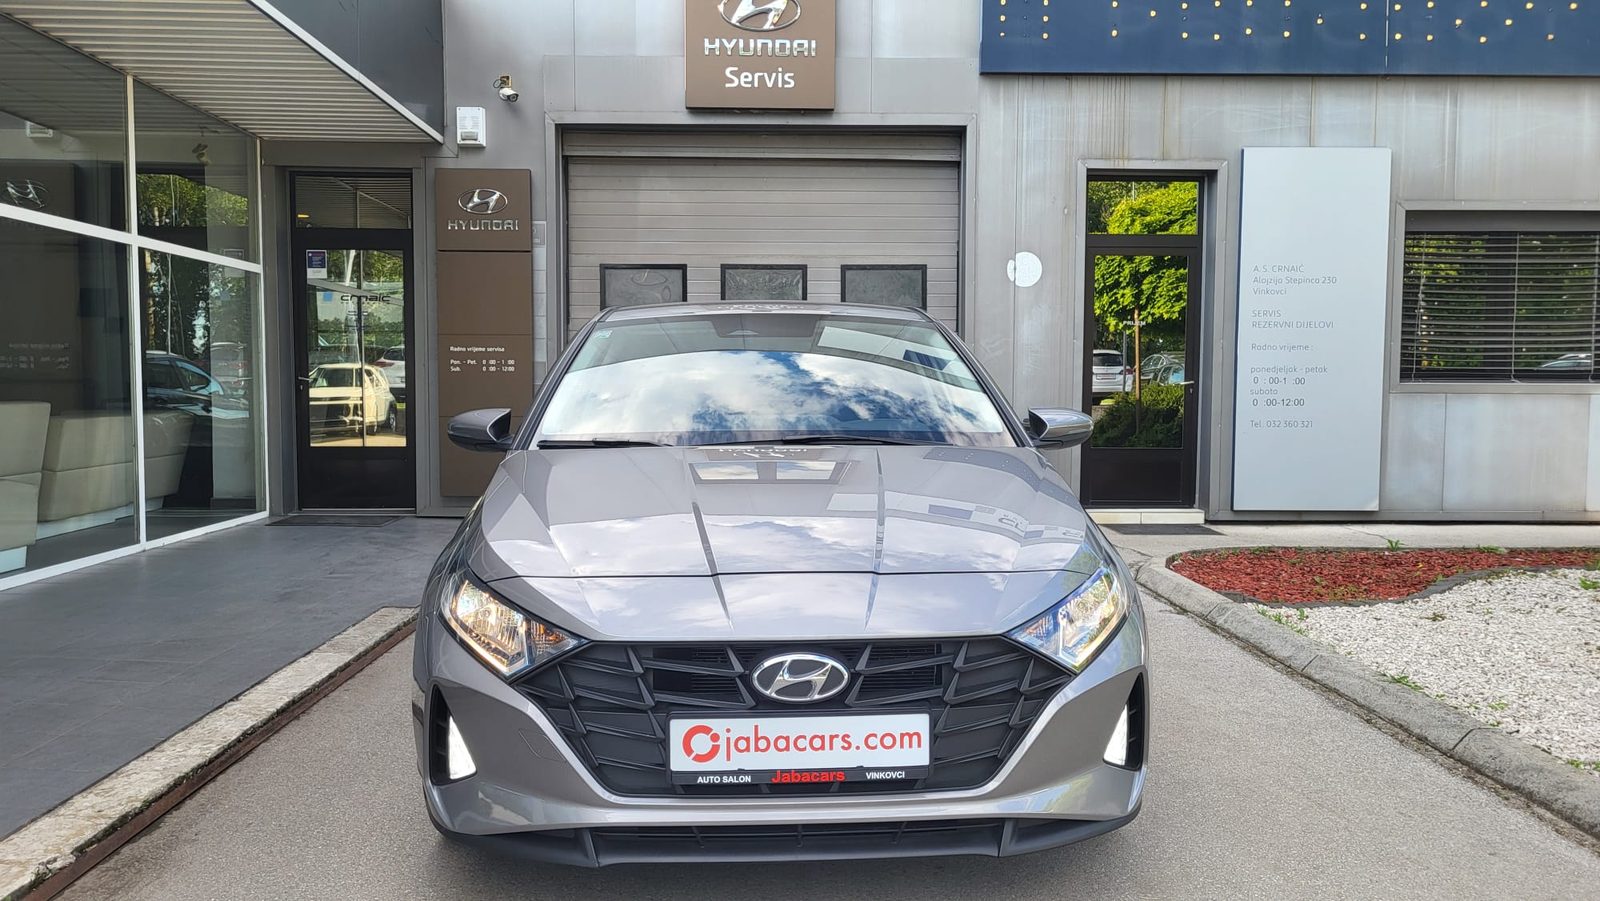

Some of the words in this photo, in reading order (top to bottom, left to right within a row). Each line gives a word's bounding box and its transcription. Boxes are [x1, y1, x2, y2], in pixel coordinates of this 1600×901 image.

[704, 38, 817, 57] HYUNDAI
[724, 66, 795, 88] Servis
[447, 219, 519, 231] HYUNDAI
[1253, 276, 1284, 286] Alojzija
[1285, 276, 1320, 285] Stepinca
[1321, 276, 1337, 285] 230
[1252, 309, 1282, 318] SERVIS
[1252, 320, 1294, 329] REZERVNI
[1295, 320, 1334, 329] DIJELOVI
[1251, 343, 1278, 351] Radno
[1279, 343, 1310, 353] vrijeme
[1250, 365, 1298, 374] ponedjeljak
[1304, 365, 1328, 375] petak
[1249, 387, 1279, 396] subota
[1266, 419, 1282, 428] 032
[1283, 419, 1298, 428] 360
[1299, 419, 1313, 428] 321
[725, 725, 922, 762] jabacars.com
[697, 775, 721, 783] AUTO
[722, 774, 752, 783] SALON
[771, 770, 846, 784] Jabacars
[865, 770, 906, 780] VINKOVCI
